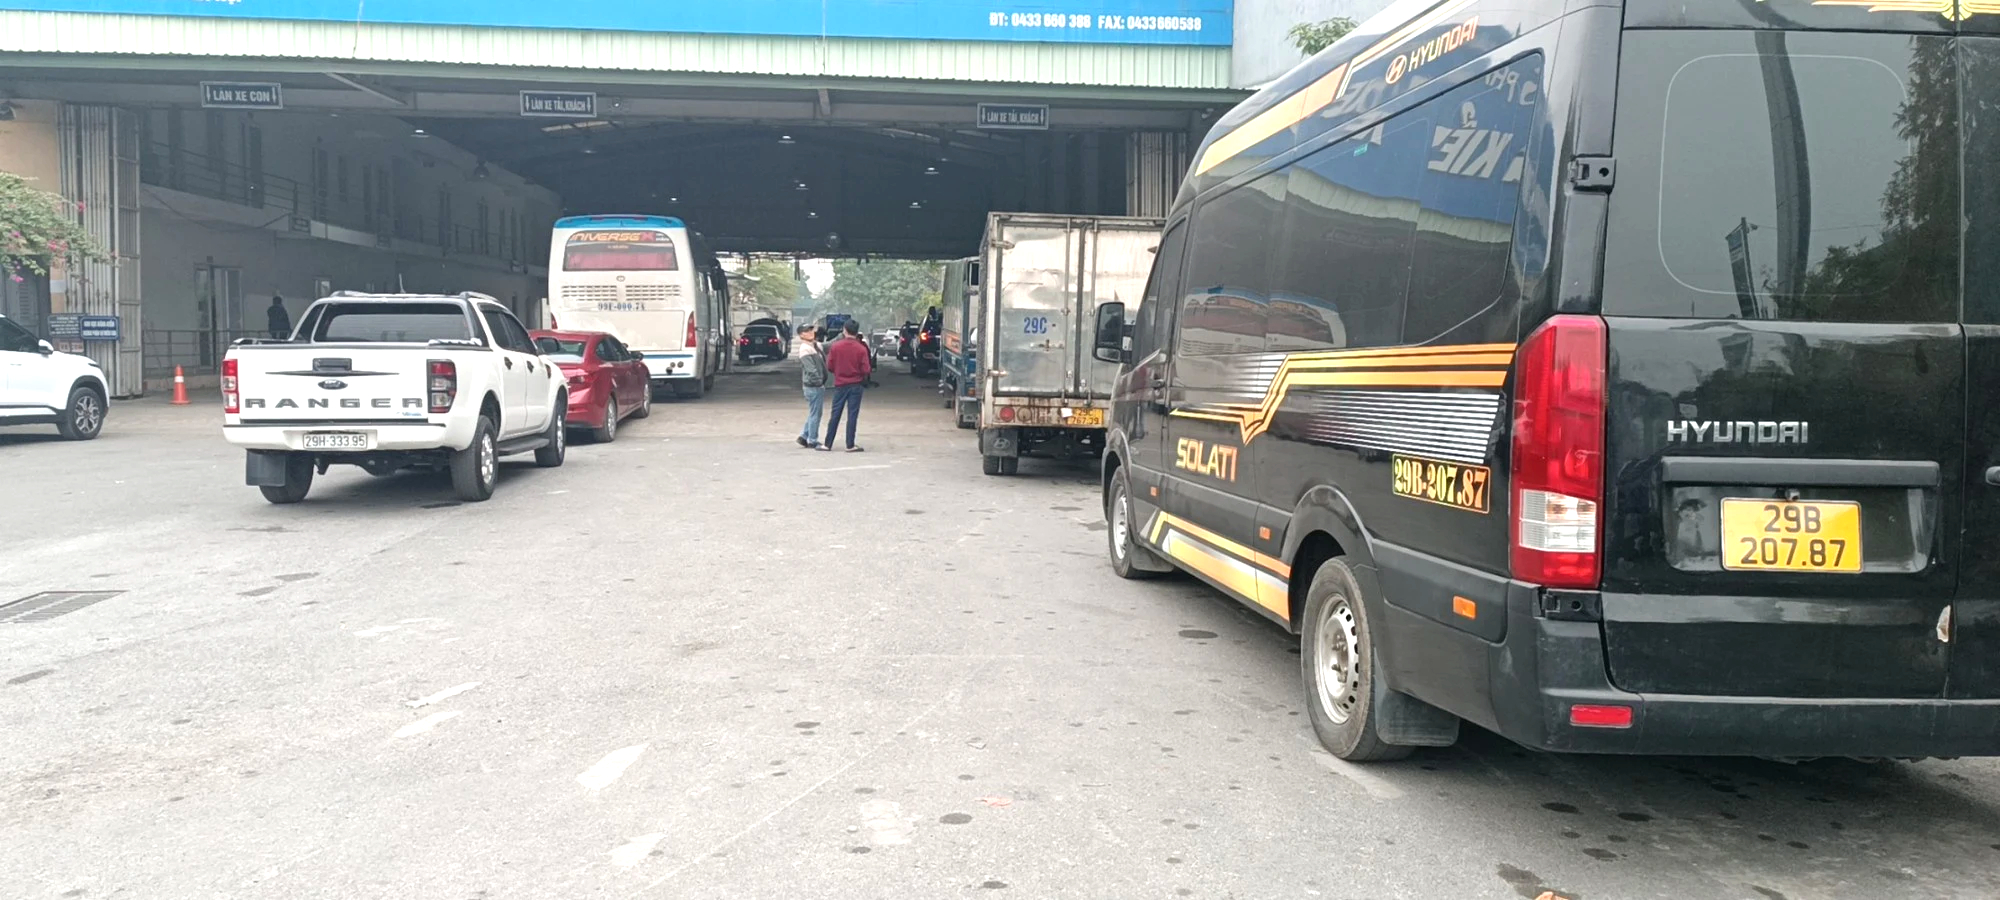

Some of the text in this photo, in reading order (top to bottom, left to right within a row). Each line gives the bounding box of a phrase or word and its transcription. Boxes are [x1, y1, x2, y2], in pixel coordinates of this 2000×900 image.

[1011, 13, 1042, 27] 0433
[1044, 13, 1066, 28] 660
[1098, 15, 1125, 30] FAX:
[1408, 15, 1480, 72] HYUNDAI
[235, 91, 248, 102] XE
[249, 91, 270, 102] CON
[1023, 317, 1048, 334] 29C
[245, 398, 423, 409] RANGER
[1667, 420, 1809, 444] HYUNDAI
[1175, 437, 1238, 482] SOLATI
[1394, 458, 1488, 509] 29B-207.87
[1763, 505, 1821, 533] 29B
[1740, 537, 1846, 567] 207.87
